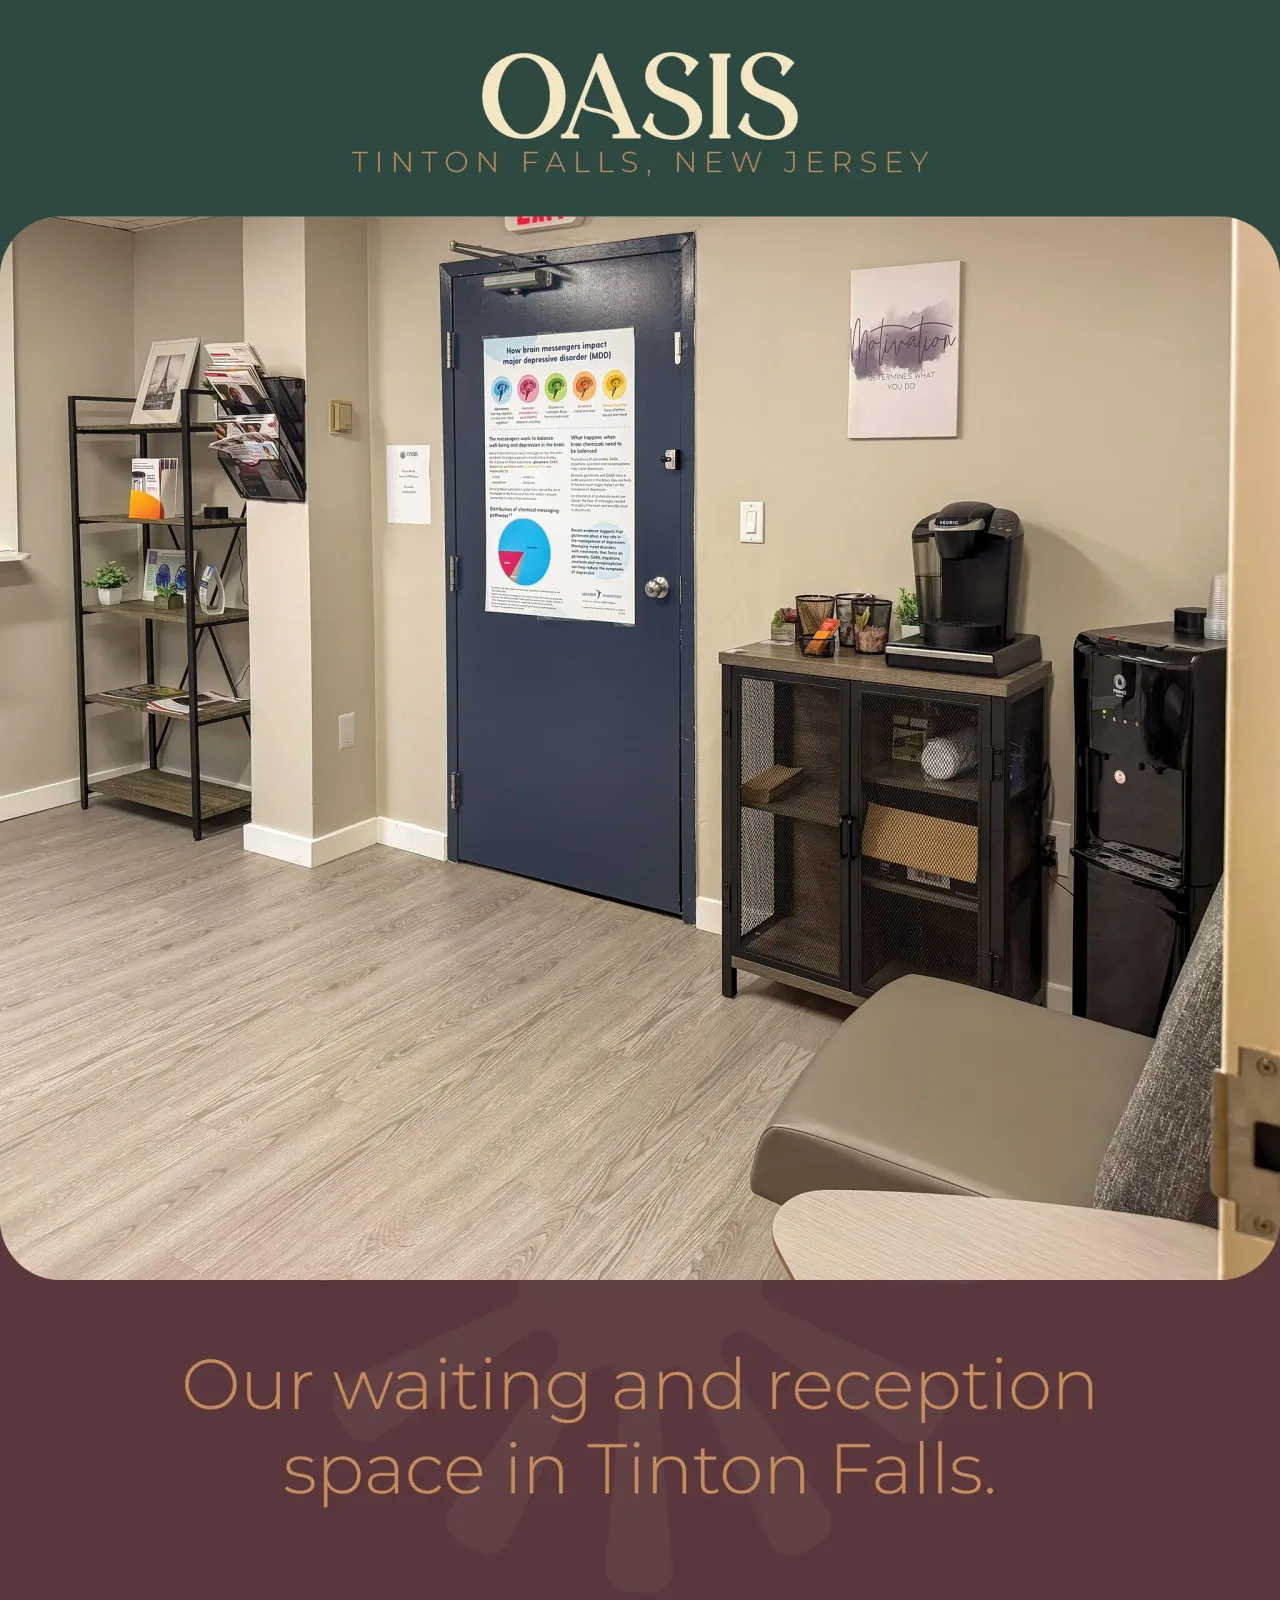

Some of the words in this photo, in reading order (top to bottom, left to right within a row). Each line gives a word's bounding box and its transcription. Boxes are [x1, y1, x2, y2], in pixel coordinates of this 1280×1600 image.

[542, 343, 581, 352] messengers
[582, 341, 607, 350] impact
[850, 316, 956, 369] Motivation
[503, 358, 521, 366] major
[524, 355, 558, 365] depressive
[560, 353, 587, 362] disorder
[589, 351, 611, 361] (MDD)
[869, 373, 912, 381] DETERMINES
